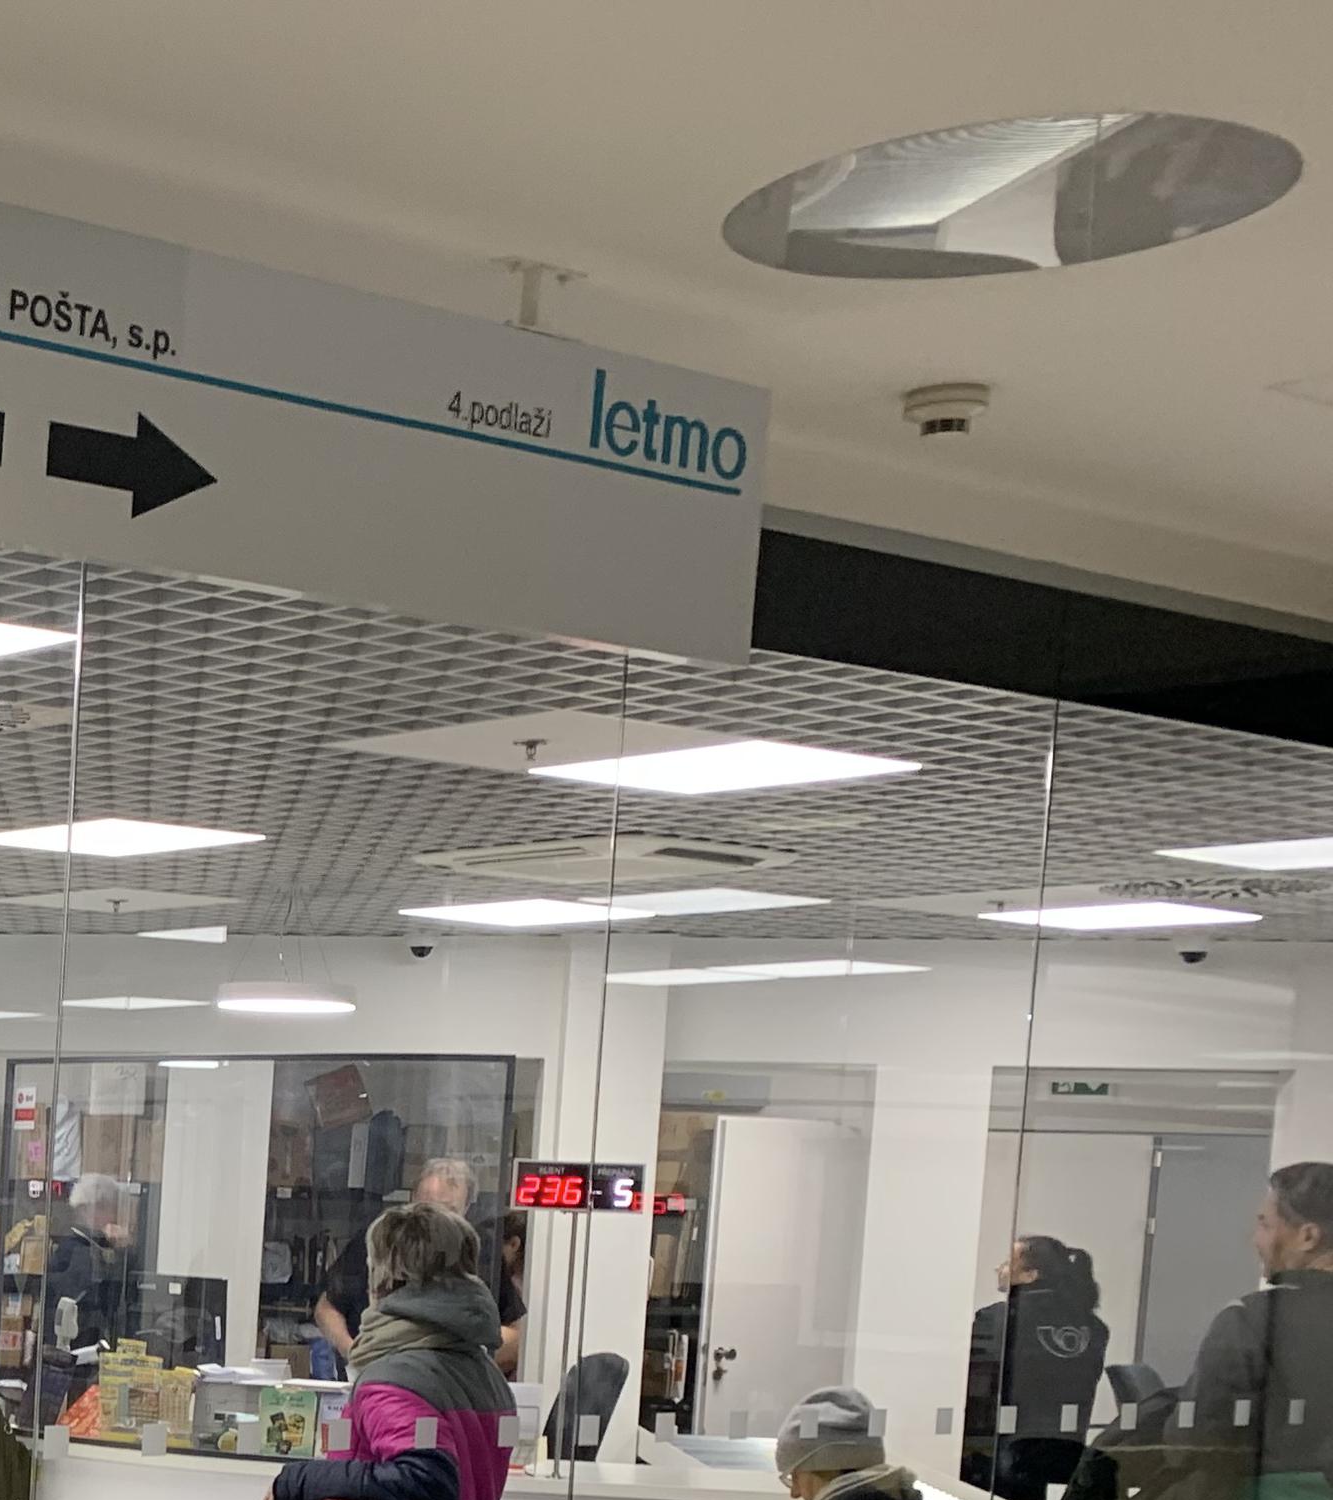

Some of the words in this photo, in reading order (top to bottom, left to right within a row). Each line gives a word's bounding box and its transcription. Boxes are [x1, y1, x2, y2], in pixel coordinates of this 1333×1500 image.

[9, 288, 118, 349] POŠTA,
[128, 324, 177, 361] s.p.
[589, 368, 747, 481] letmo
[517, 1176, 584, 1205] 236
[613, 1178, 635, 1208] 5
